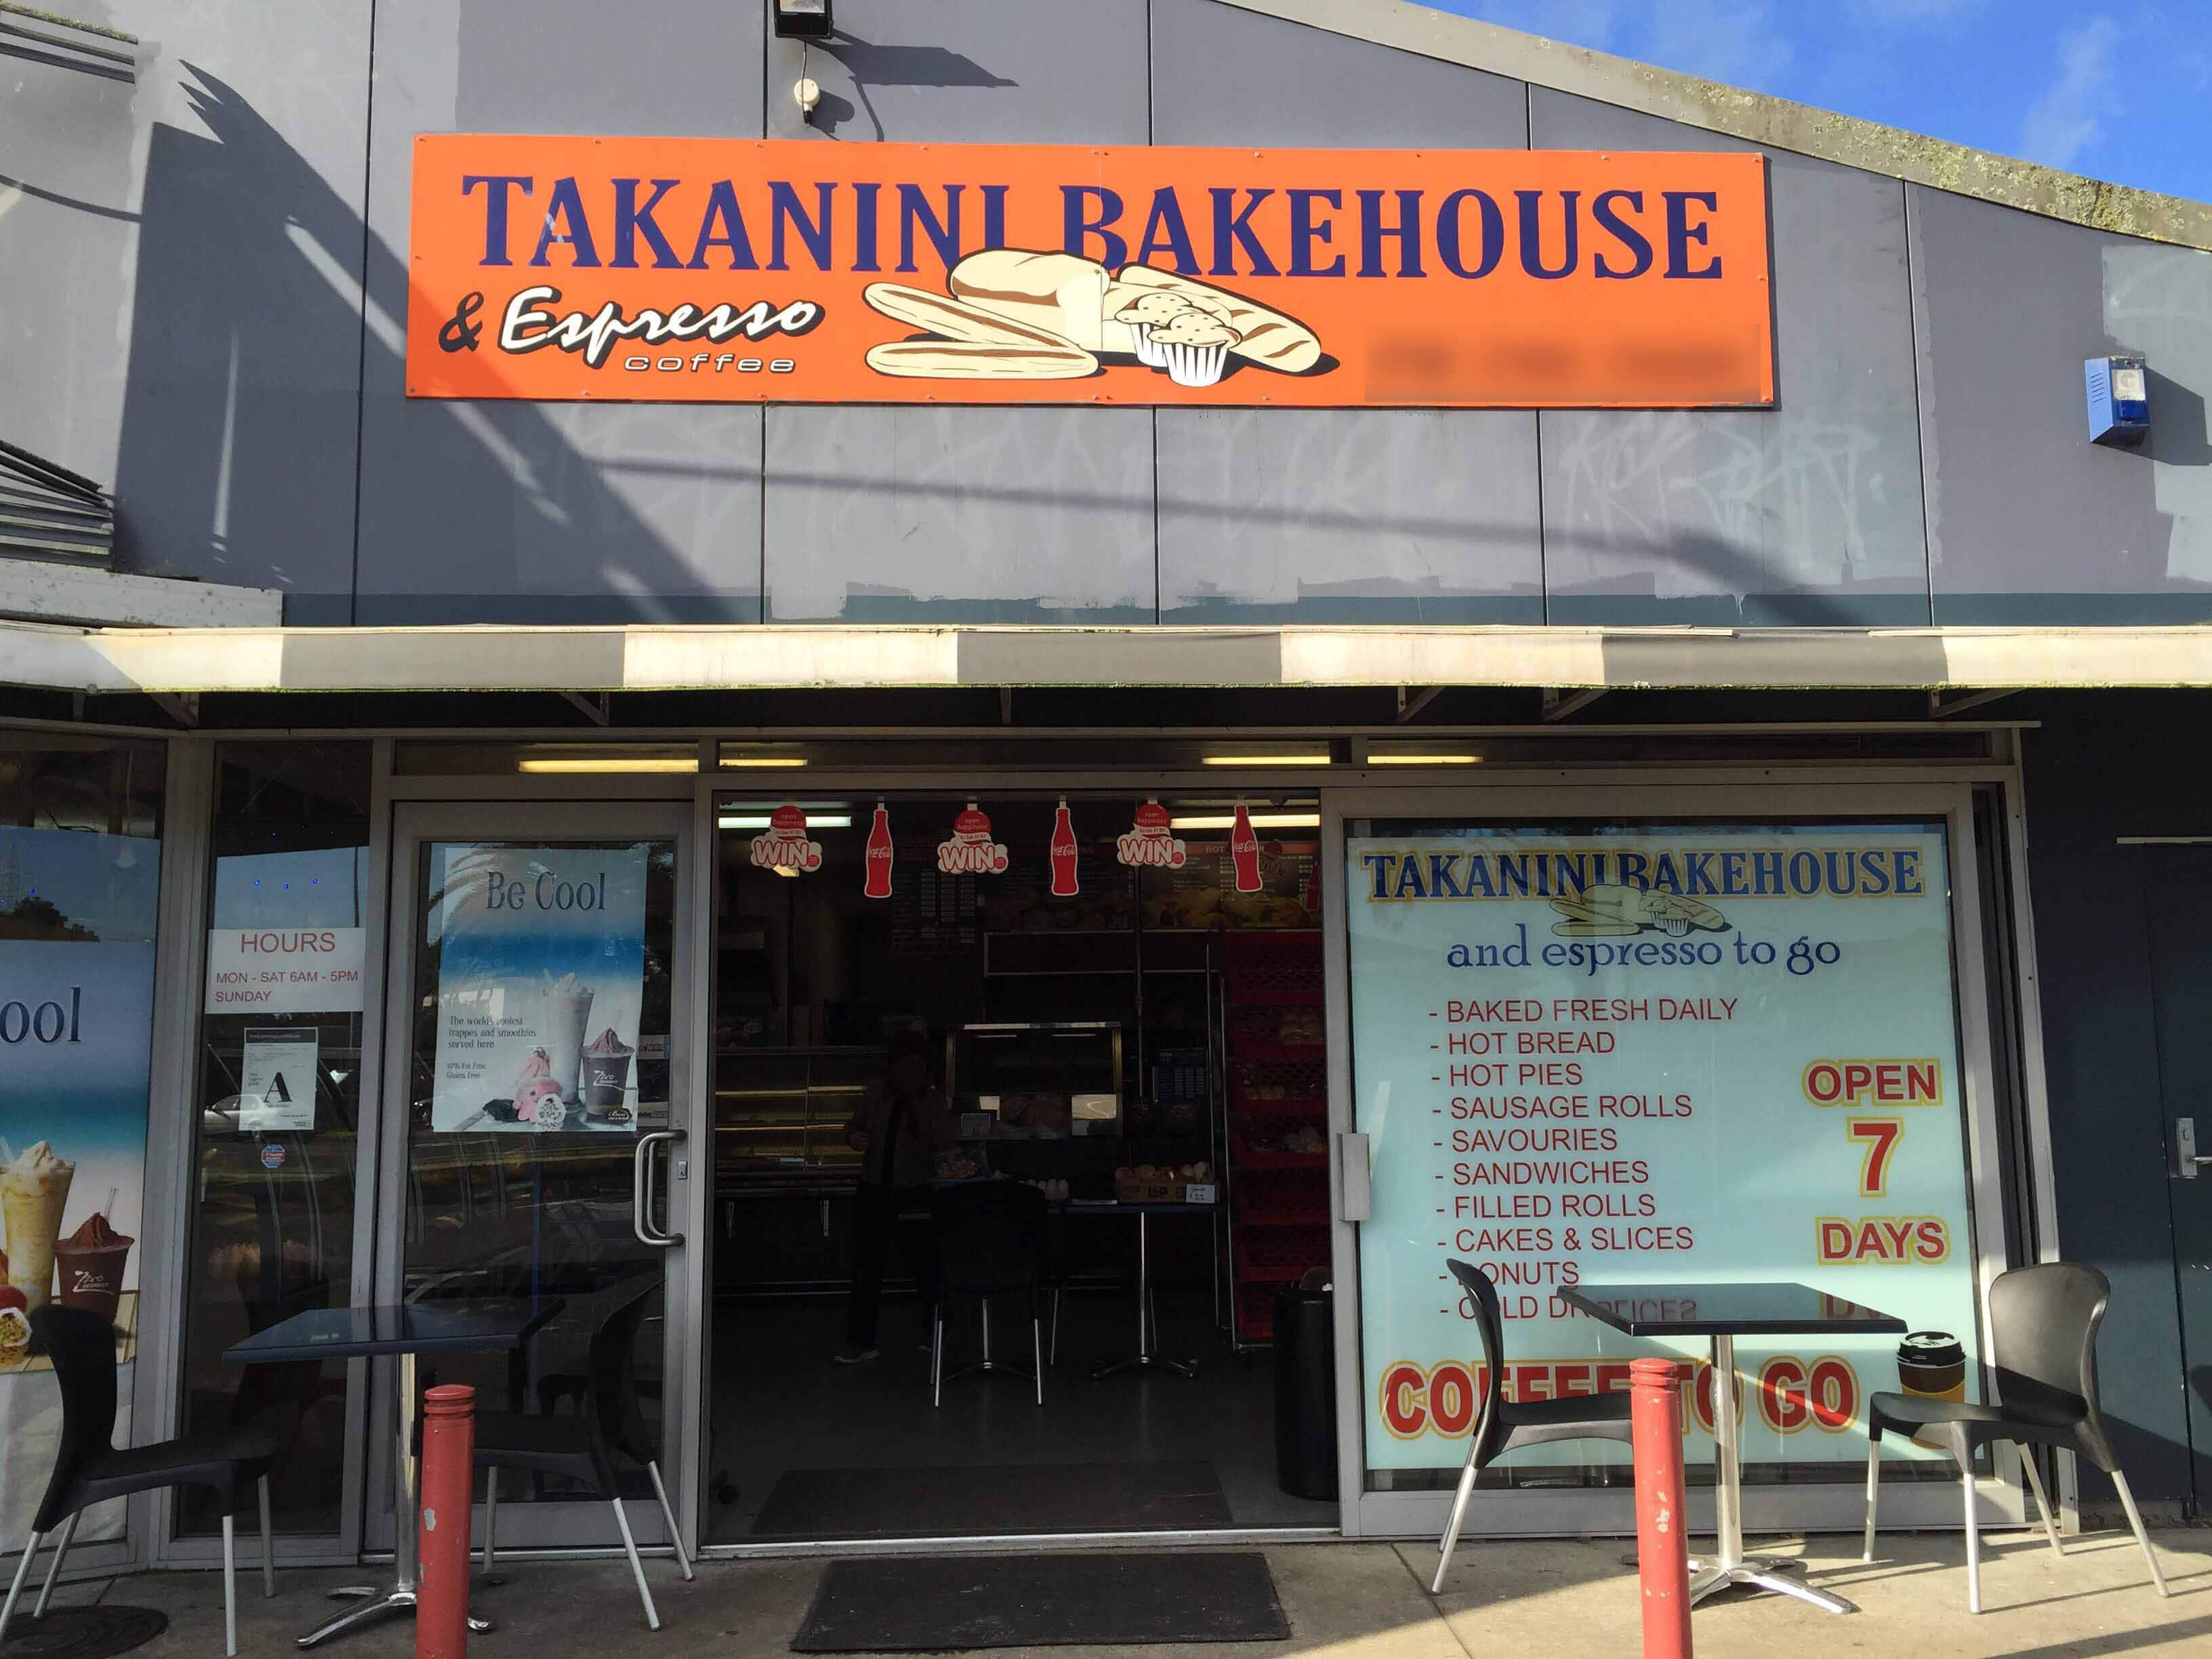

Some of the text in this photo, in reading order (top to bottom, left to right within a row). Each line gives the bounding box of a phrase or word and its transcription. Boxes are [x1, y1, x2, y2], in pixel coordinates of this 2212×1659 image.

[462, 175, 1722, 279] TAKANINI BAKEHOUSE
[438, 285, 825, 370] & Espresso
[623, 353, 795, 373] coffee
[754, 840, 808, 867] WIN
[941, 846, 995, 870] WIN
[1120, 839, 1173, 863] WIN
[1364, 854, 1605, 898] TAKANINI
[1616, 851, 1922, 895] BAKEHOUSE
[487, 872, 605, 910] Be Cool
[241, 932, 336, 953] HOURS
[1447, 923, 1841, 976] and espresso to go
[217, 972, 248, 983] MON
[260, 971, 286, 983] SAT
[290, 971, 318, 982] 6AM
[331, 970, 358, 982] 5PM
[215, 990, 271, 1002] SUNDAY
[450, 1016, 464, 1025] The
[1447, 1000, 1542, 1023] BAKED
[1553, 999, 1648, 1021] FRESH
[1659, 998, 1738, 1021] DAILY
[448, 1040, 474, 1048] served
[480, 1028, 495, 1037] and
[1449, 1033, 1507, 1055] HOT
[1517, 1031, 1615, 1054] BREAD
[1450, 1064, 1509, 1086] HOT
[1519, 1063, 1582, 1085] PIES
[1807, 1065, 1936, 1101] OPEN
[263, 1071, 293, 1103] A
[1451, 1096, 1589, 1120] SAUSAGE
[1599, 1094, 1692, 1118] ROLLS
[1452, 1128, 1617, 1152] SAVOURIES
[1853, 1122, 1898, 1191] 7
[1453, 1161, 1649, 1185] SANDWICHES
[1454, 1195, 1551, 1218] FILLED
[1562, 1193, 1656, 1217] ROLLS
[1456, 1228, 1553, 1252] CAKES
[1563, 1227, 1582, 1251] &
[1591, 1227, 1694, 1251] SLICES
[1822, 1221, 1945, 1258] DAYS
[1458, 1261, 1579, 1285] ONUTS
[1458, 1296, 1538, 1319] CLD
[1763, 1361, 1853, 1427] GO
